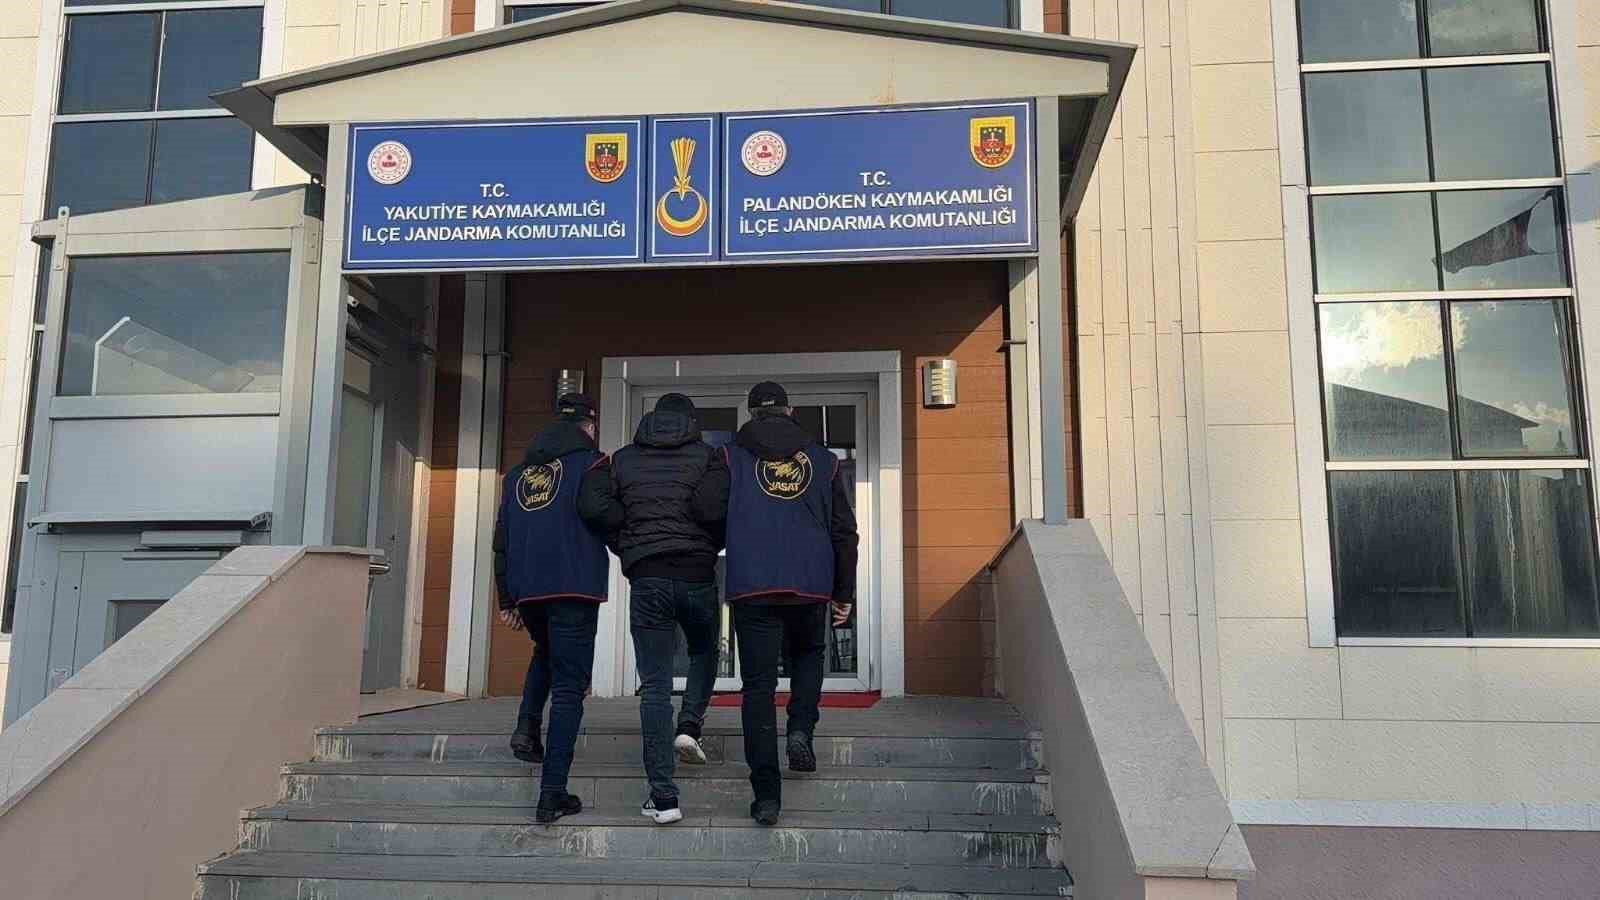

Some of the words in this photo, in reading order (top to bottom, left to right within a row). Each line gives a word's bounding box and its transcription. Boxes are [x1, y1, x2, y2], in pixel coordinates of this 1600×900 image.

[860, 171, 891, 186] T.C.
[480, 183, 509, 198] T.C.
[743, 193, 866, 212] PALANDÖKEN
[871, 185, 1012, 208] KAYMAKAMLIĞI
[384, 203, 467, 220] YAKUTİYE
[472, 200, 605, 219] KAYMAKAMLIĞI
[740, 216, 779, 237] İLÇE
[783, 213, 886, 233] JANDARMA
[890, 206, 1016, 229] KOMUTANLIĞI
[362, 225, 400, 246] İLÇE
[404, 225, 502, 241] JANDARMA
[506, 220, 626, 239] KOMUTANLIĞI
